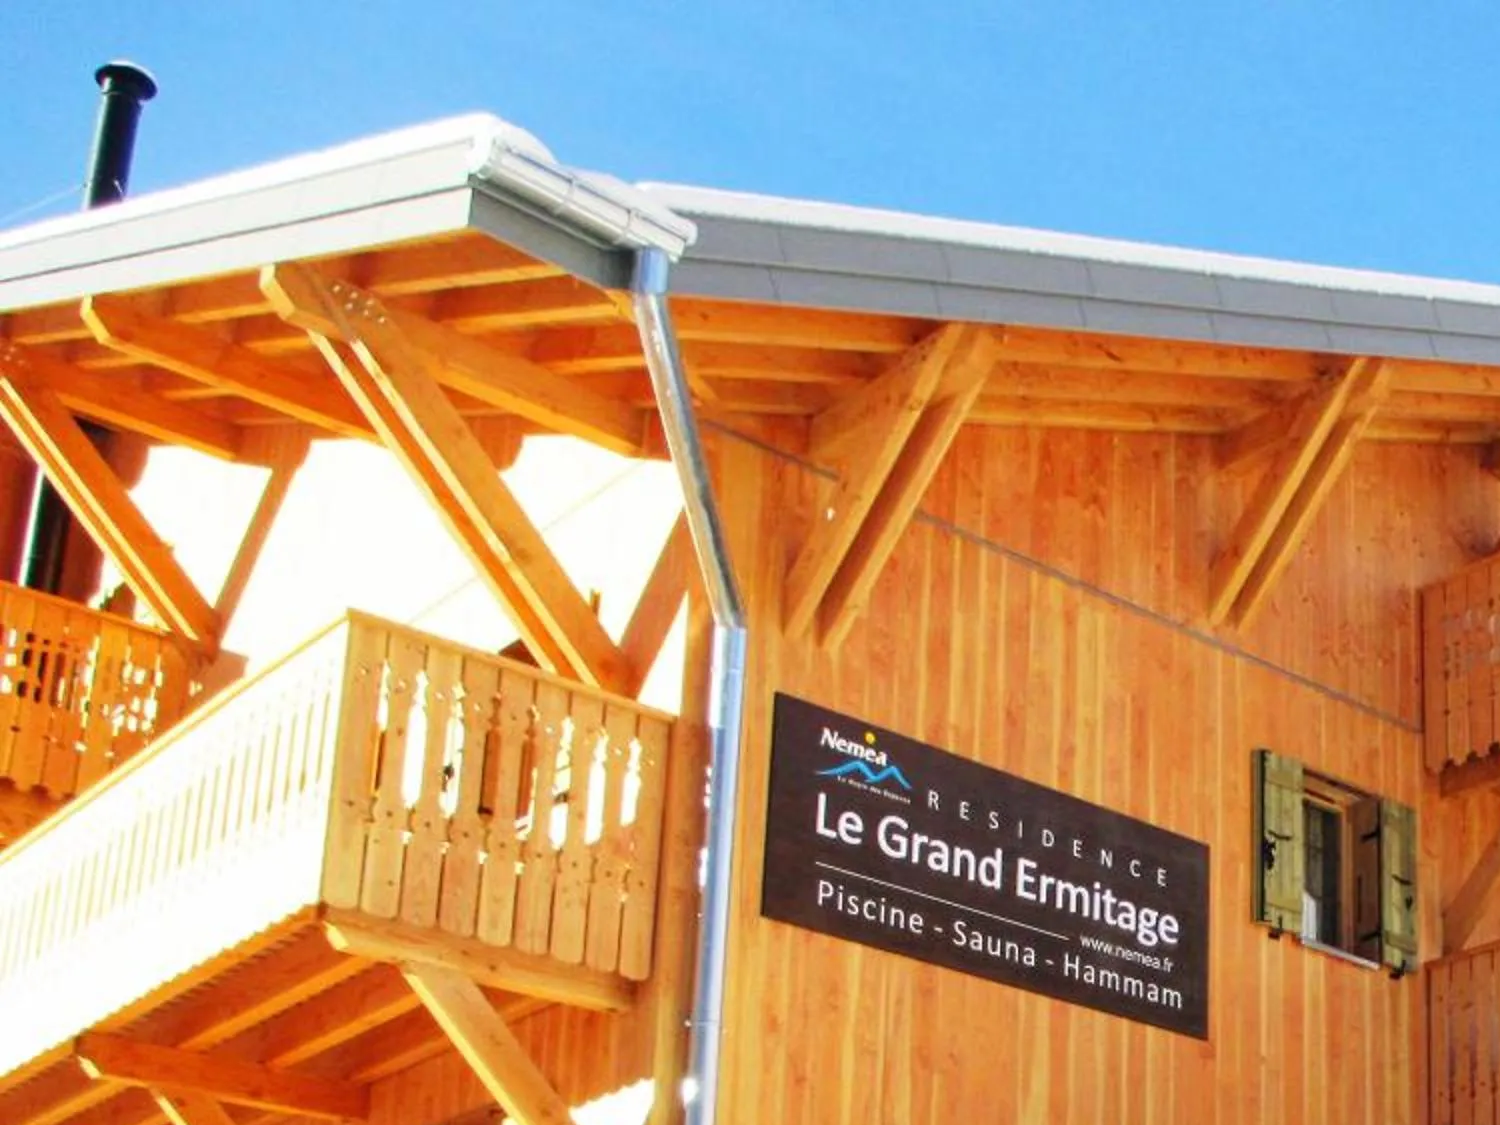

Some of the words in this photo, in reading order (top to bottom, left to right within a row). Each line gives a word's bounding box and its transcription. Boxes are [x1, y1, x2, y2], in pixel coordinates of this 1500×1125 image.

[815, 792, 864, 845] Le
[877, 815, 1003, 890] Grand
[1016, 857, 1180, 946] Ermitage
[928, 790, 1168, 887] RESIDENCE
[817, 879, 924, 934] Piscine
[952, 920, 1036, 967] Sauna
[1064, 953, 1183, 1009] Hammam
[1079, 933, 1175, 973] www.nemea.fr
